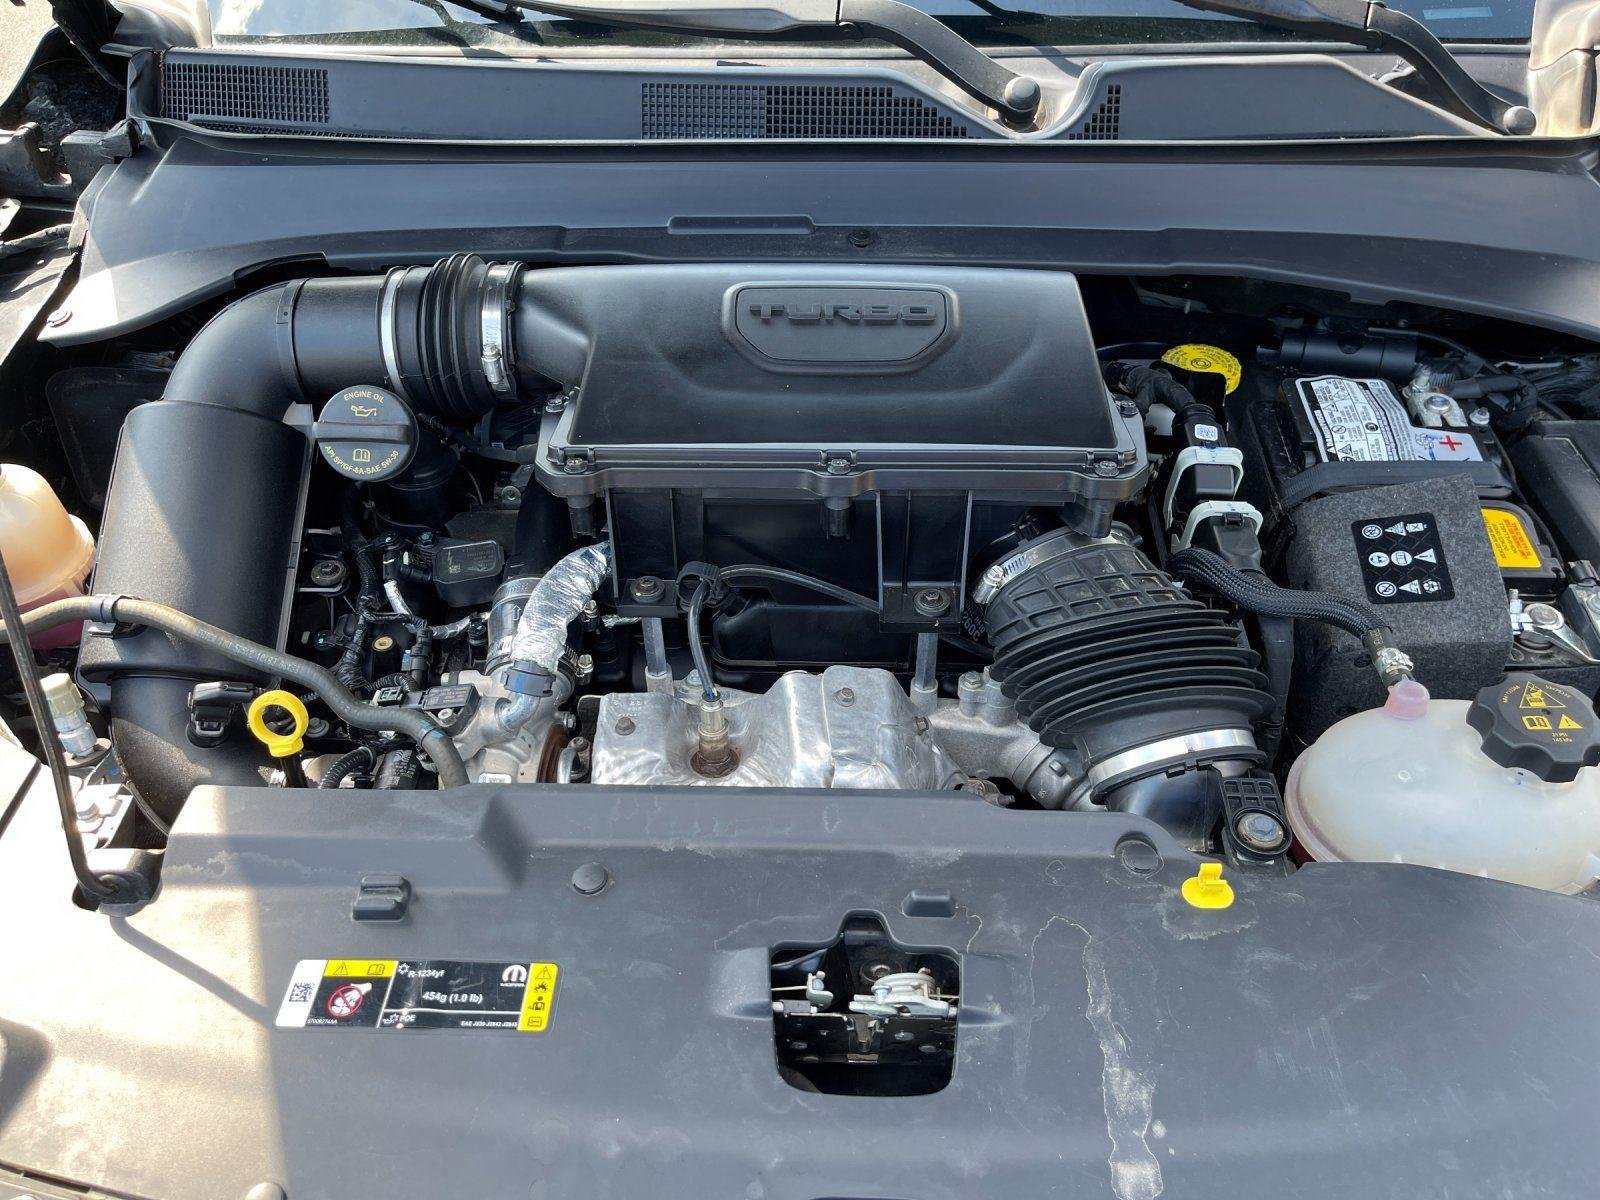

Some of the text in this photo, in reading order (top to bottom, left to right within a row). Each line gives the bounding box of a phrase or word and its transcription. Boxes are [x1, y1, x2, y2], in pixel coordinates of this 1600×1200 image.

[749, 303, 936, 322] TURBO
[343, 390, 384, 404] ENGINE OIL
[324, 445, 335, 458] API
[381, 450, 399, 469] 5W-30
[408, 969, 445, 979] R-1234yf
[422, 991, 483, 1005] 454g (1.0 lb)
